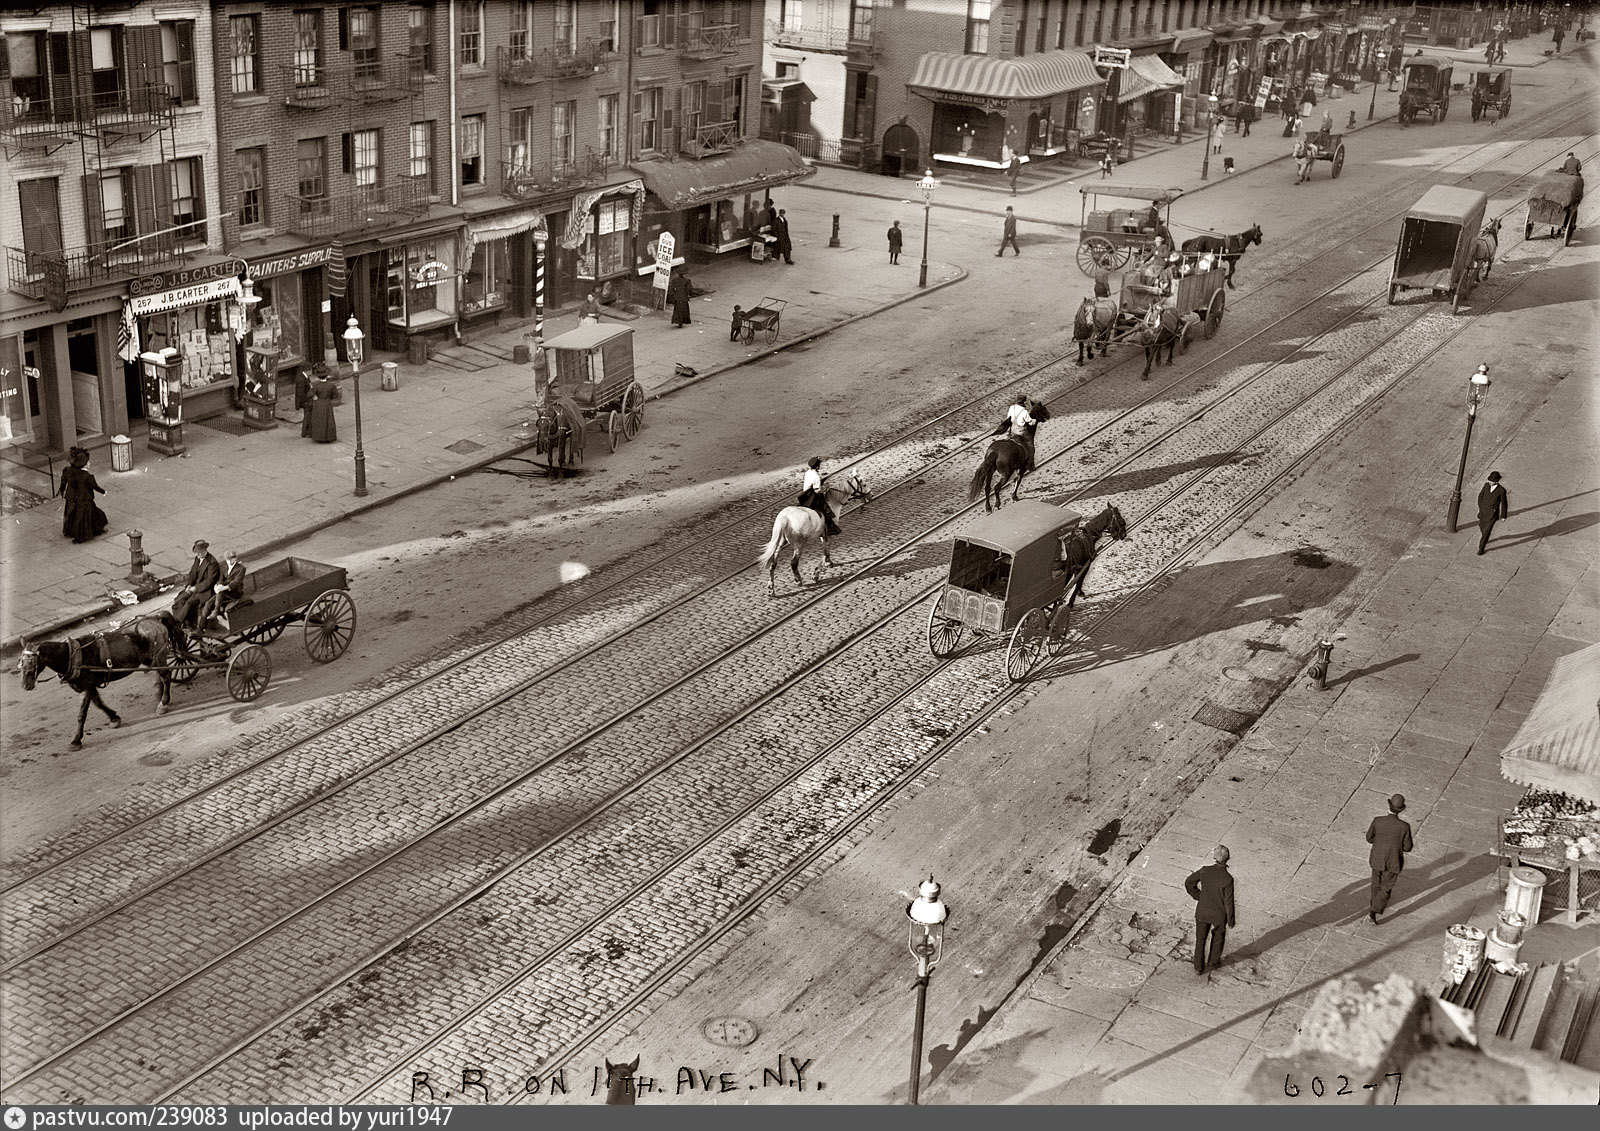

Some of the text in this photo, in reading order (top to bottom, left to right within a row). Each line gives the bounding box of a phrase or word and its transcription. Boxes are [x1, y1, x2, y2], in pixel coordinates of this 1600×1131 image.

[659, 245, 673, 255] ICE
[657, 253, 672, 264] COAL
[248, 256, 297, 278] PAINTERS
[656, 266, 670, 277] WOOD
[137, 298, 152, 309] 267
[217, 281, 230, 291] 267
[525, 1068, 567, 1097] ON
[676, 1066, 755, 1095] AVE.
